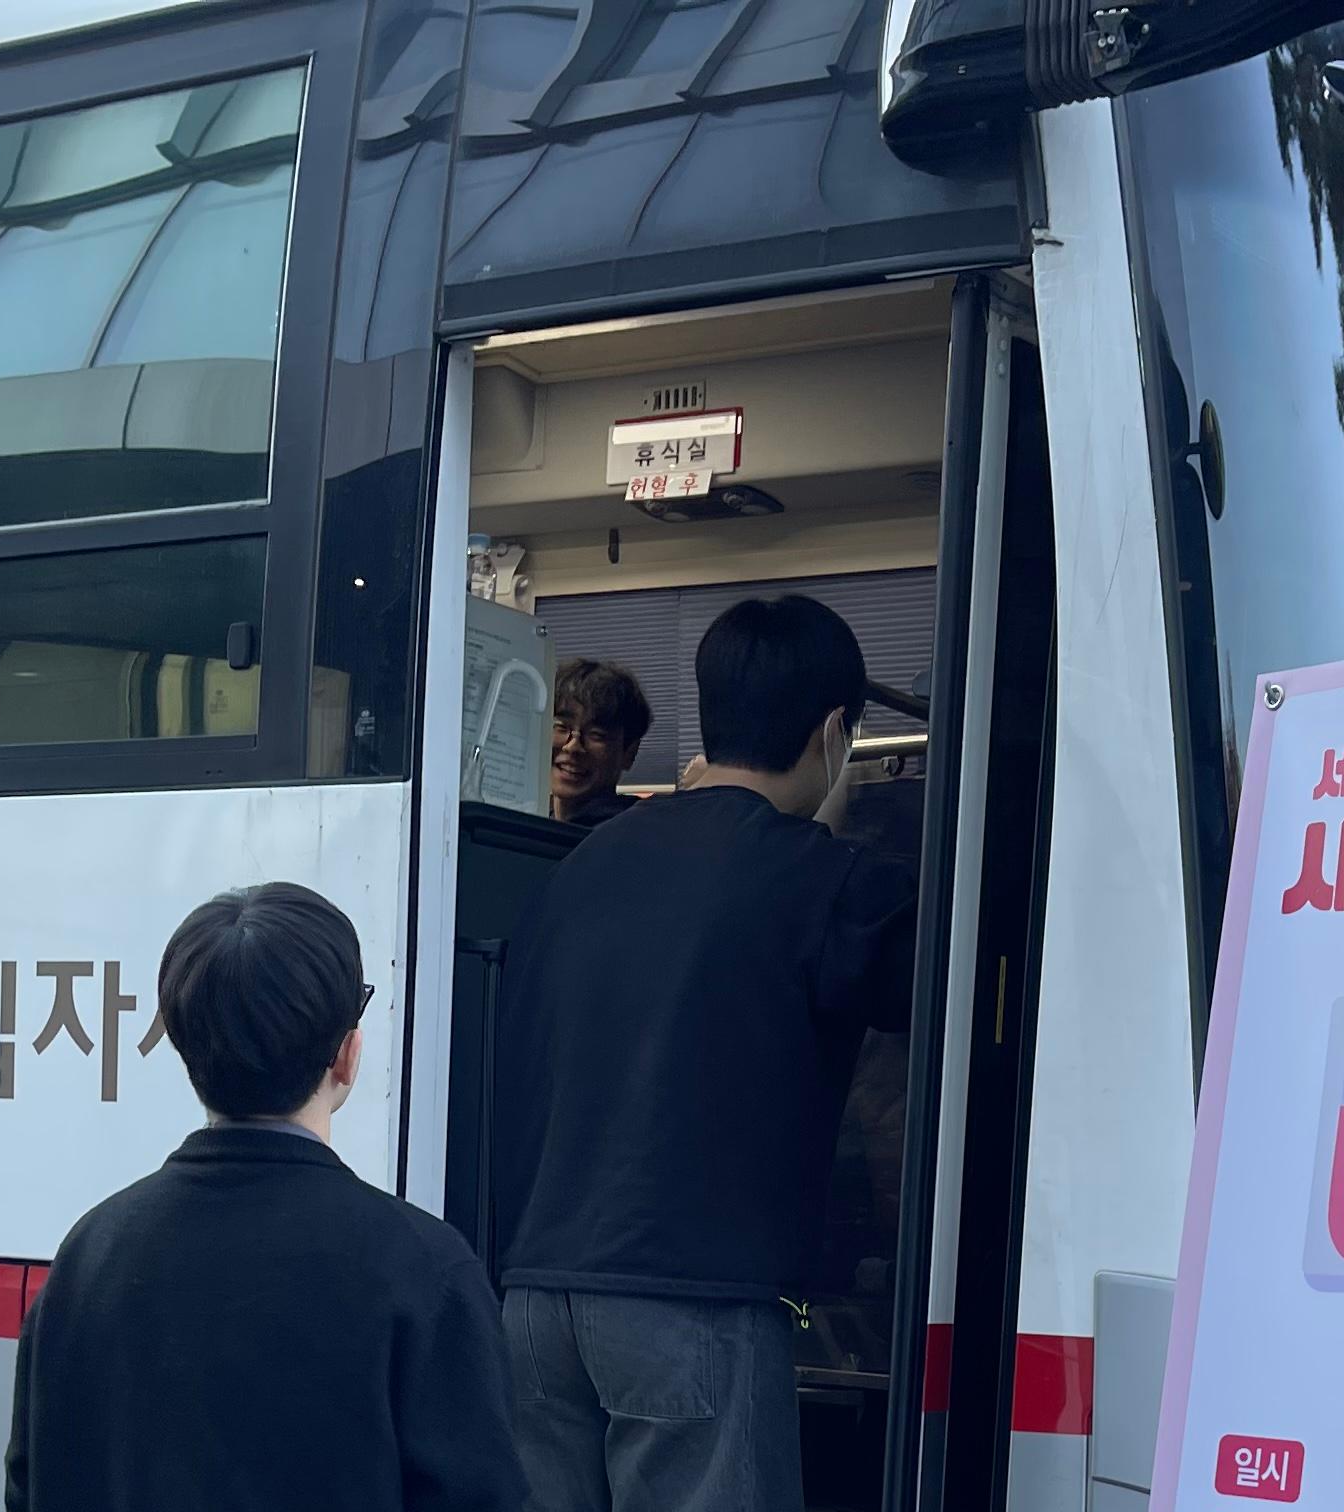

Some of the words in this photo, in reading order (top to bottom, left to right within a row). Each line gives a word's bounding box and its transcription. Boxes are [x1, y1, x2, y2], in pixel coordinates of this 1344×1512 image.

[631, 474, 668, 499] 헌혈
[679, 472, 698, 496] 후
[1234, 1447, 1290, 1491] 일시
